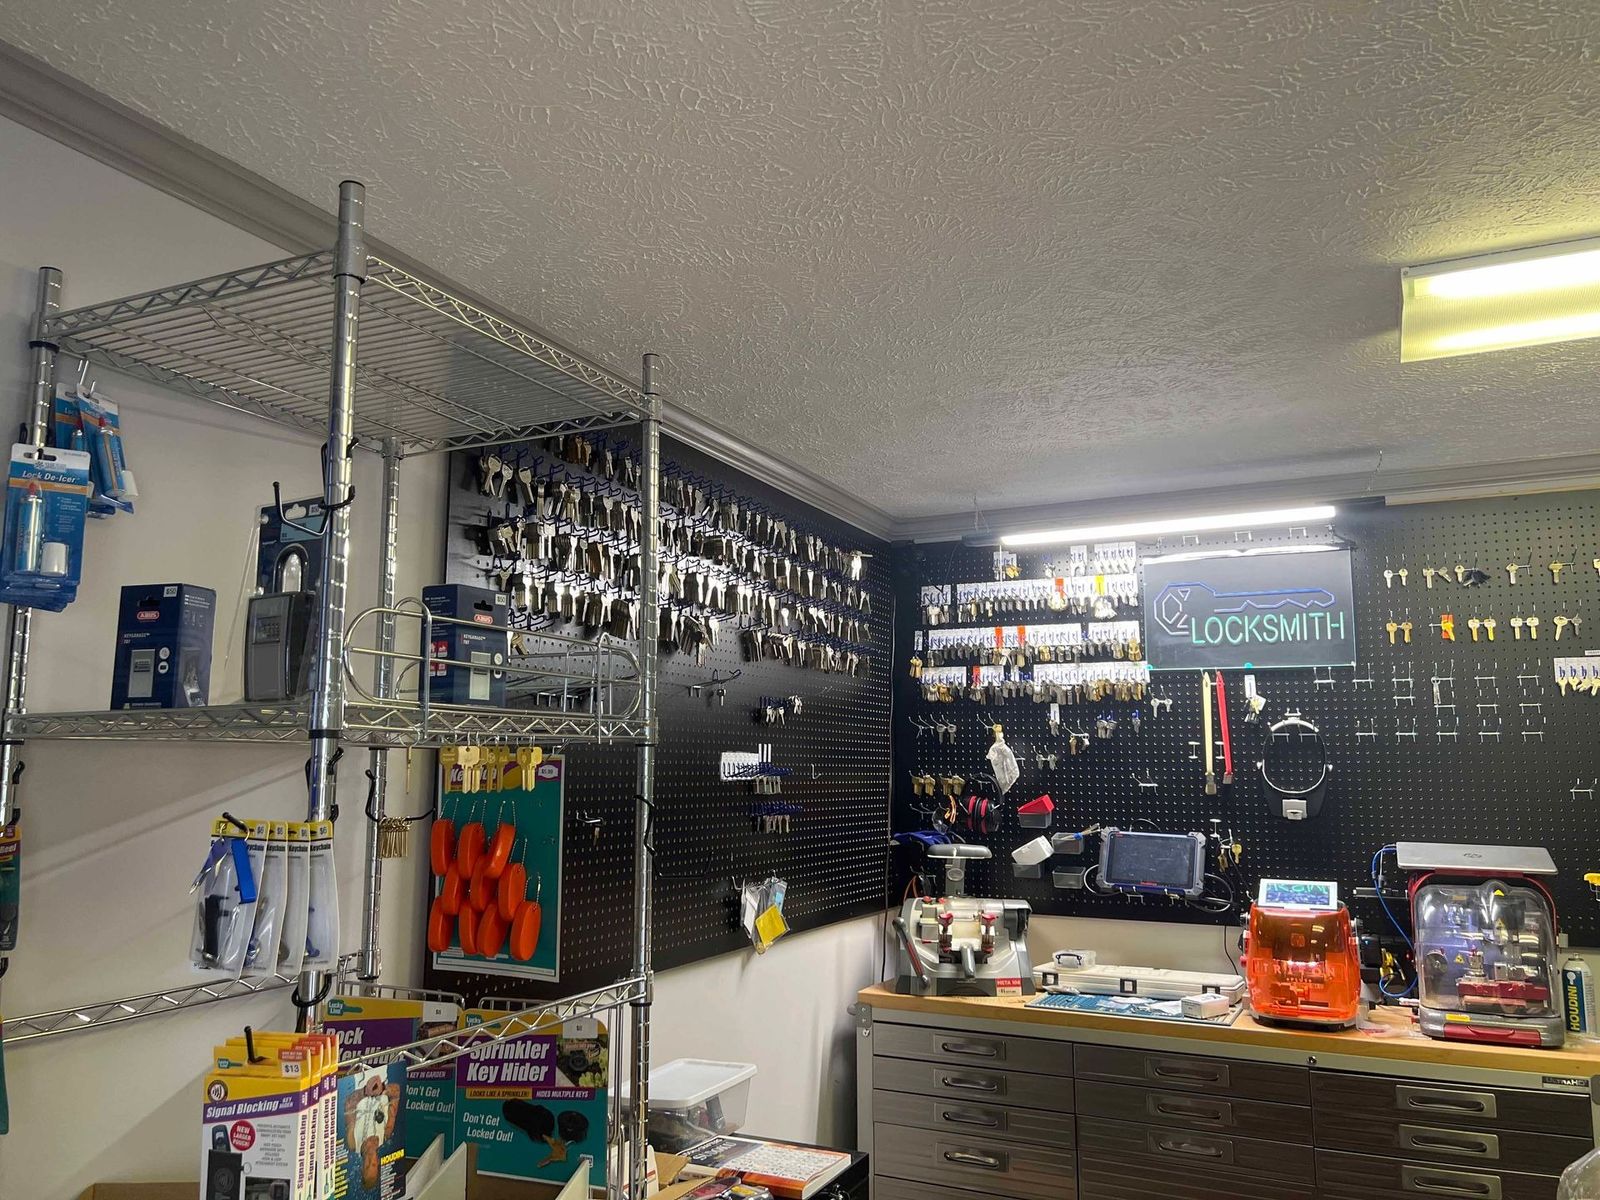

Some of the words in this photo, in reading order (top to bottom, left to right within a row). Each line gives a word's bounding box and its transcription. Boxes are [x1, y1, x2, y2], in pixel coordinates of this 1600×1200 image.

[44, 472, 76, 483] De-Icer
[1192, 611, 1344, 644] LOCKSMITH
[310, 843, 331, 851] Keychain
[1568, 985, 1580, 1031] HOUDINI
[470, 1041, 550, 1061] Sprinkler
[284, 1064, 299, 1073] $13
[467, 1062, 499, 1083] Key
[501, 1062, 549, 1082] Hider
[426, 1086, 440, 1097] Get
[551, 1090, 575, 1098] MULTIPLE
[575, 1090, 589, 1098] KEYS
[206, 1103, 235, 1118] Signal
[236, 1100, 279, 1115] Blocking
[406, 1099, 435, 1111] Locked
[437, 1102, 455, 1114] Out!
[463, 1112, 484, 1123] Don't
[486, 1115, 500, 1126] Get
[299, 1114, 307, 1157] Blocking
[309, 1108, 318, 1150] Blocking
[467, 1126, 494, 1139] Locked
[496, 1130, 514, 1142] Out!
[297, 1158, 305, 1189] Signal
